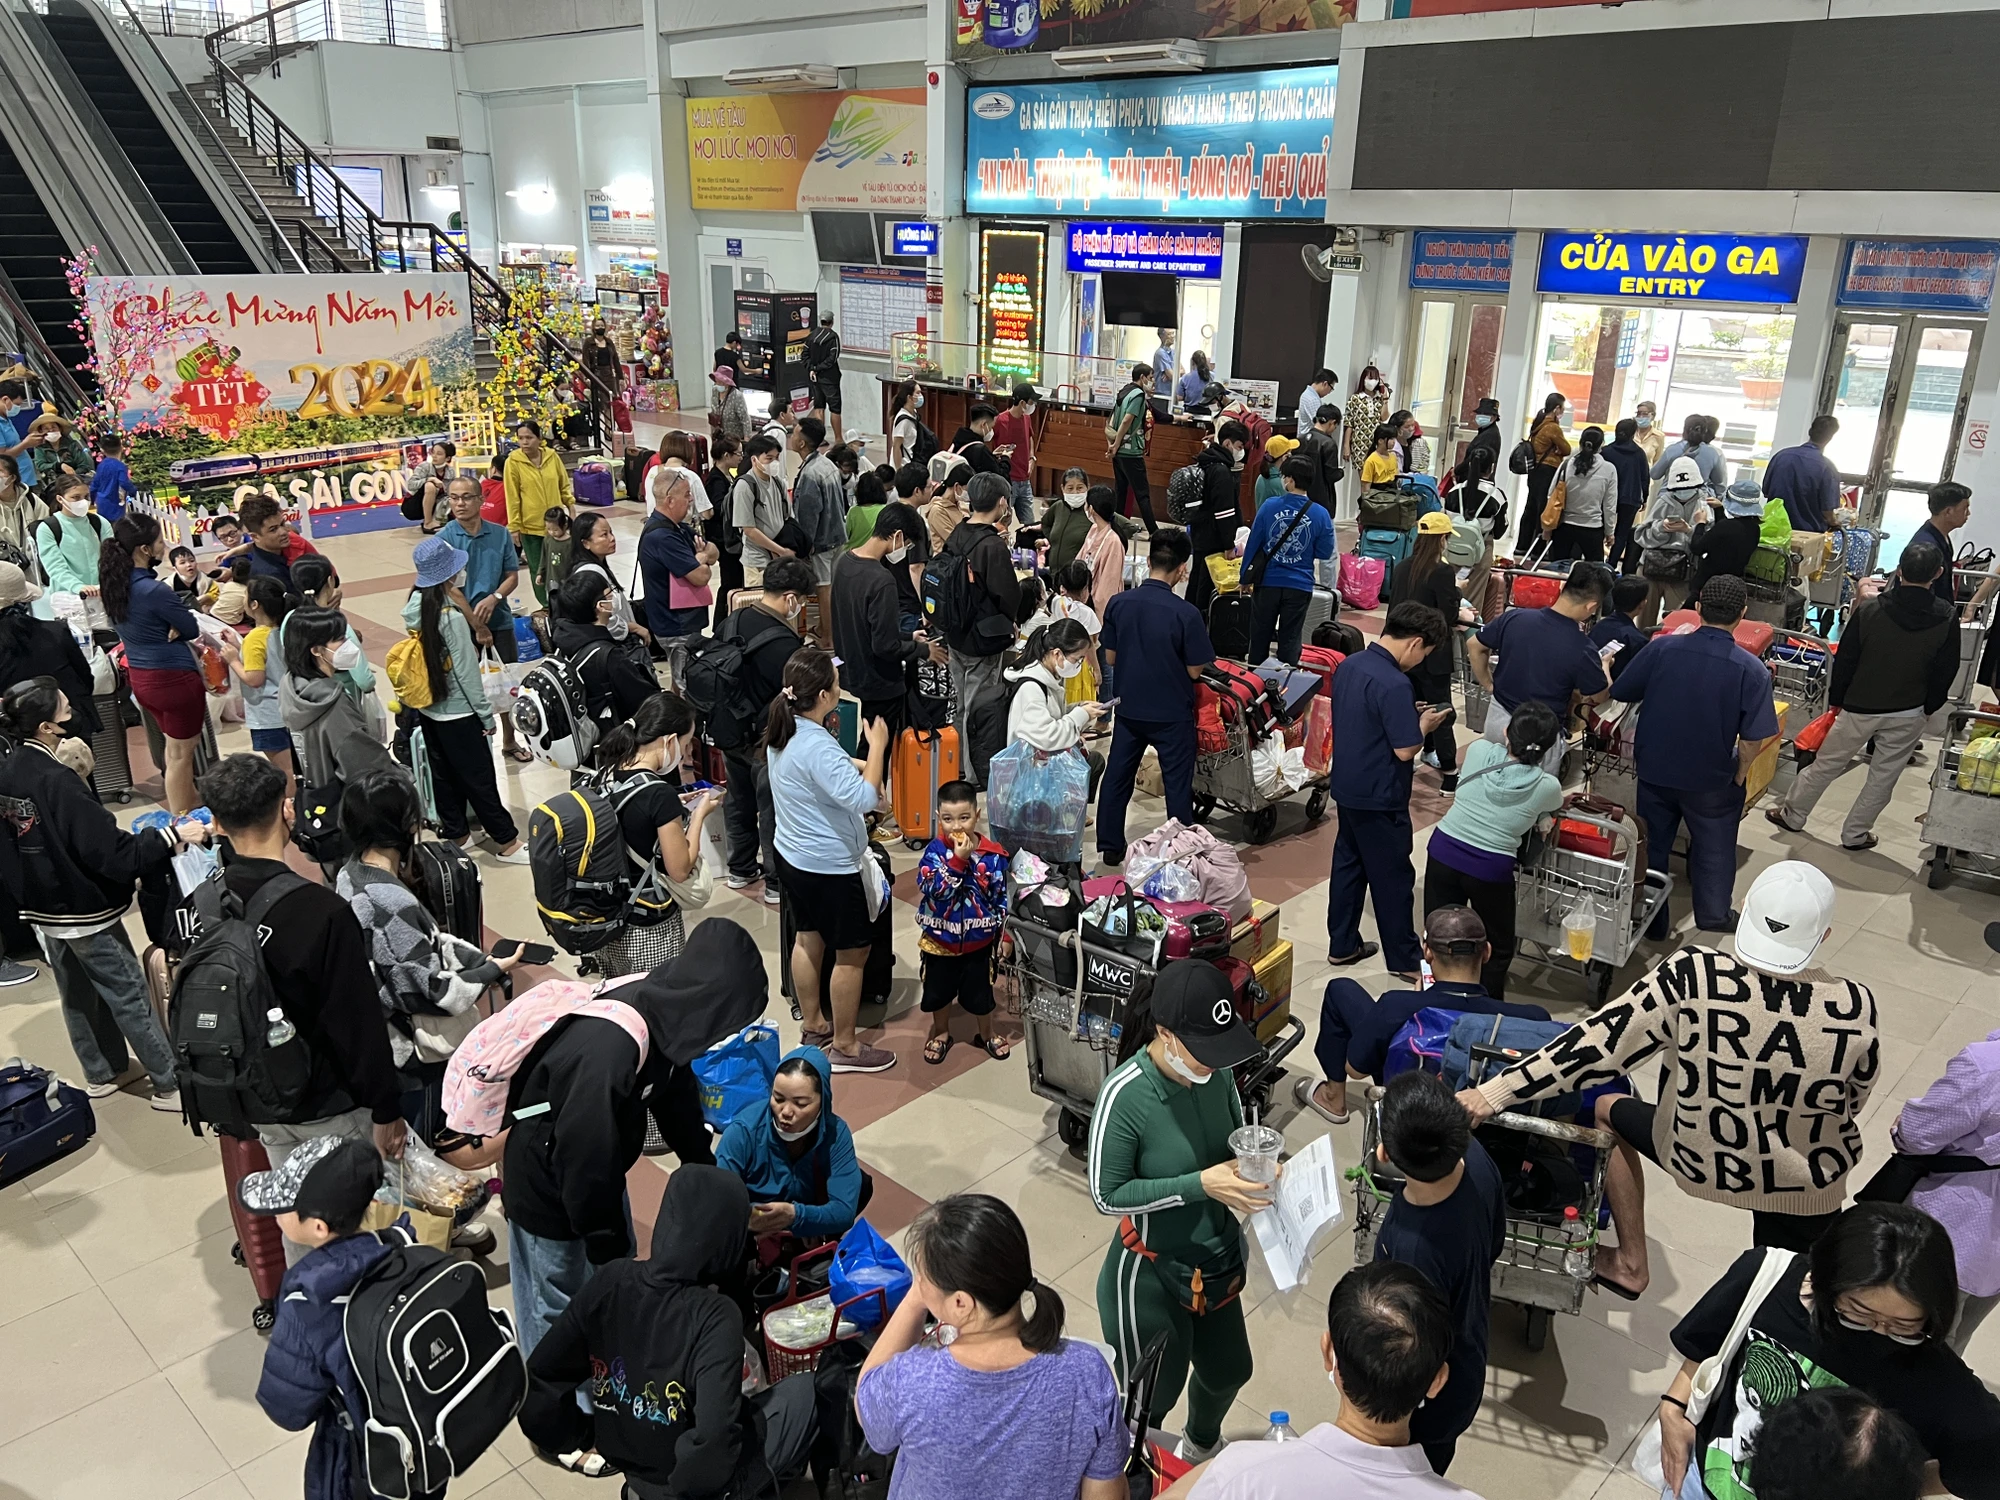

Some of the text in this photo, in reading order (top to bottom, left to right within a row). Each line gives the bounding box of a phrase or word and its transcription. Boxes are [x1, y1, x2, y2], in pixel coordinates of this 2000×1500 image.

[692, 105, 712, 128] MUA
[714, 102, 726, 128] VÉ
[1020, 102, 1031, 130] GA
[1033, 94, 1047, 130] SÀI
[1050, 93, 1067, 130] GÒN
[1069, 94, 1093, 137] THỰC
[1095, 92, 1116, 137] HIỆN
[1118, 97, 1144, 136] PHỤC
[1147, 97, 1160, 135] VỤ
[1161, 87, 1195, 126] KHÁCH
[1197, 85, 1226, 125] HÀNG
[1228, 90, 1257, 123] THEO
[694, 136, 717, 165] MỌI
[747, 135, 770, 165] MỌI
[999, 148, 1028, 199] TOÀN
[1108, 148, 1142, 199] THÂN
[1143, 147, 1182, 212] THIỆN
[1188, 143, 1226, 200] ĐÚNG
[1228, 142, 1255, 200] GIỜ
[1260, 143, 1298, 212] HIỆU
[1298, 135, 1329, 209] QUẢ
[1159, 231, 1174, 255] SÓC
[1174, 231, 1195, 256] HÀNH
[1195, 231, 1221, 256] KHÁCH
[1448, 240, 1465, 257] THÂN
[1560, 234, 1779, 276] CỬA VÀO GA
[1084, 258, 1206, 272] PASSENGER SUPPORT AND CARE DEPARTMENT
[1496, 264, 1512, 282] SOÁ
[1619, 277, 1705, 295] ENTRY
[1901, 277, 1928, 294] MINUTES
[227, 291, 327, 354] Mừng
[327, 290, 401, 334] Năm
[403, 289, 461, 324] Mới
[992, 310, 1034, 320] For customers
[996, 320, 1026, 330] coming for
[996, 328, 1018, 338] picking
[190, 374, 249, 407] TẾT
[289, 356, 440, 419] 2024
[289, 469, 342, 510] SÀI
[1274, 510, 1290, 520] EAT
[1091, 958, 1130, 986] MWC
